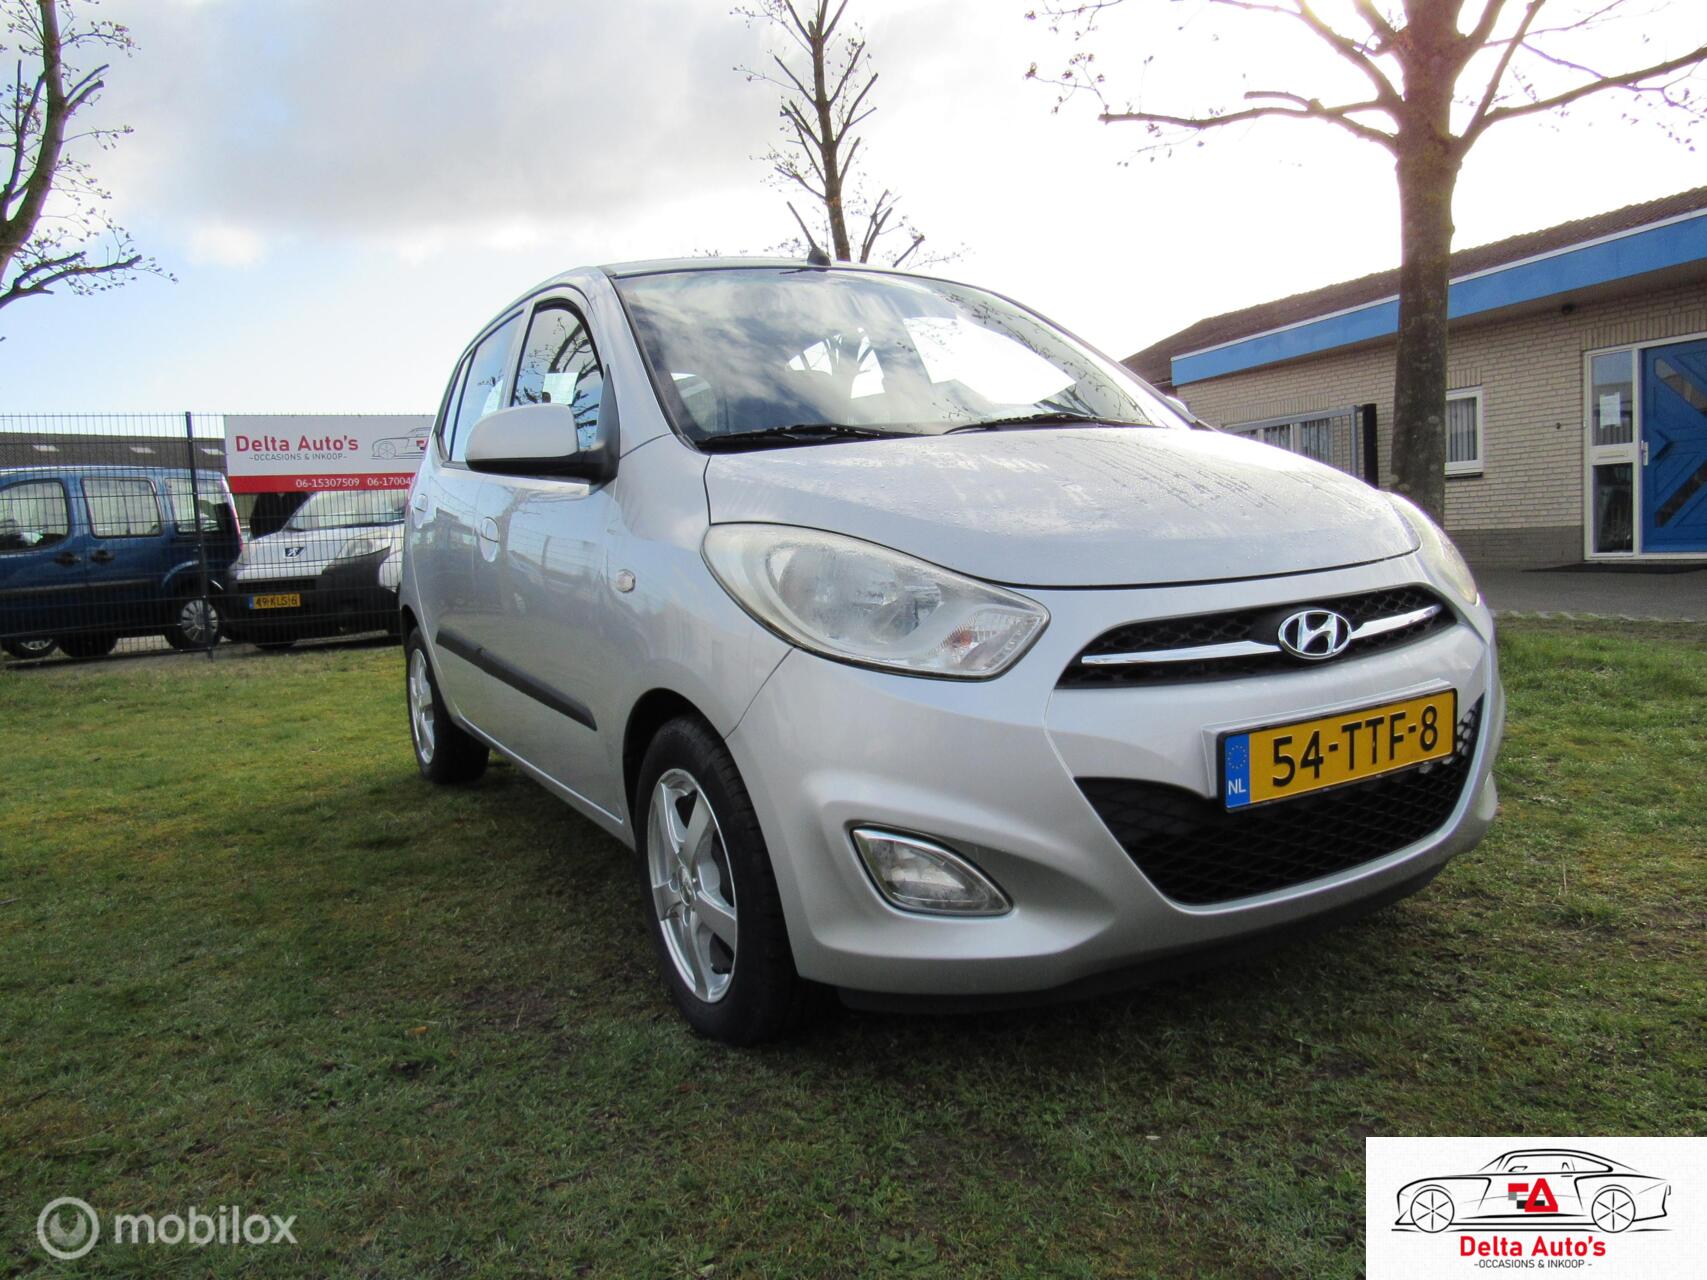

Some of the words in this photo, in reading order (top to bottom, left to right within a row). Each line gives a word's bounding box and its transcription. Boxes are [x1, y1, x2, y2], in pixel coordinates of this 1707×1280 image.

[235, 435, 290, 452] Delta
[297, 434, 359, 451] Auto's
[1272, 704, 1438, 787] 54-TTF-8
[1228, 779, 1246, 795] NL
